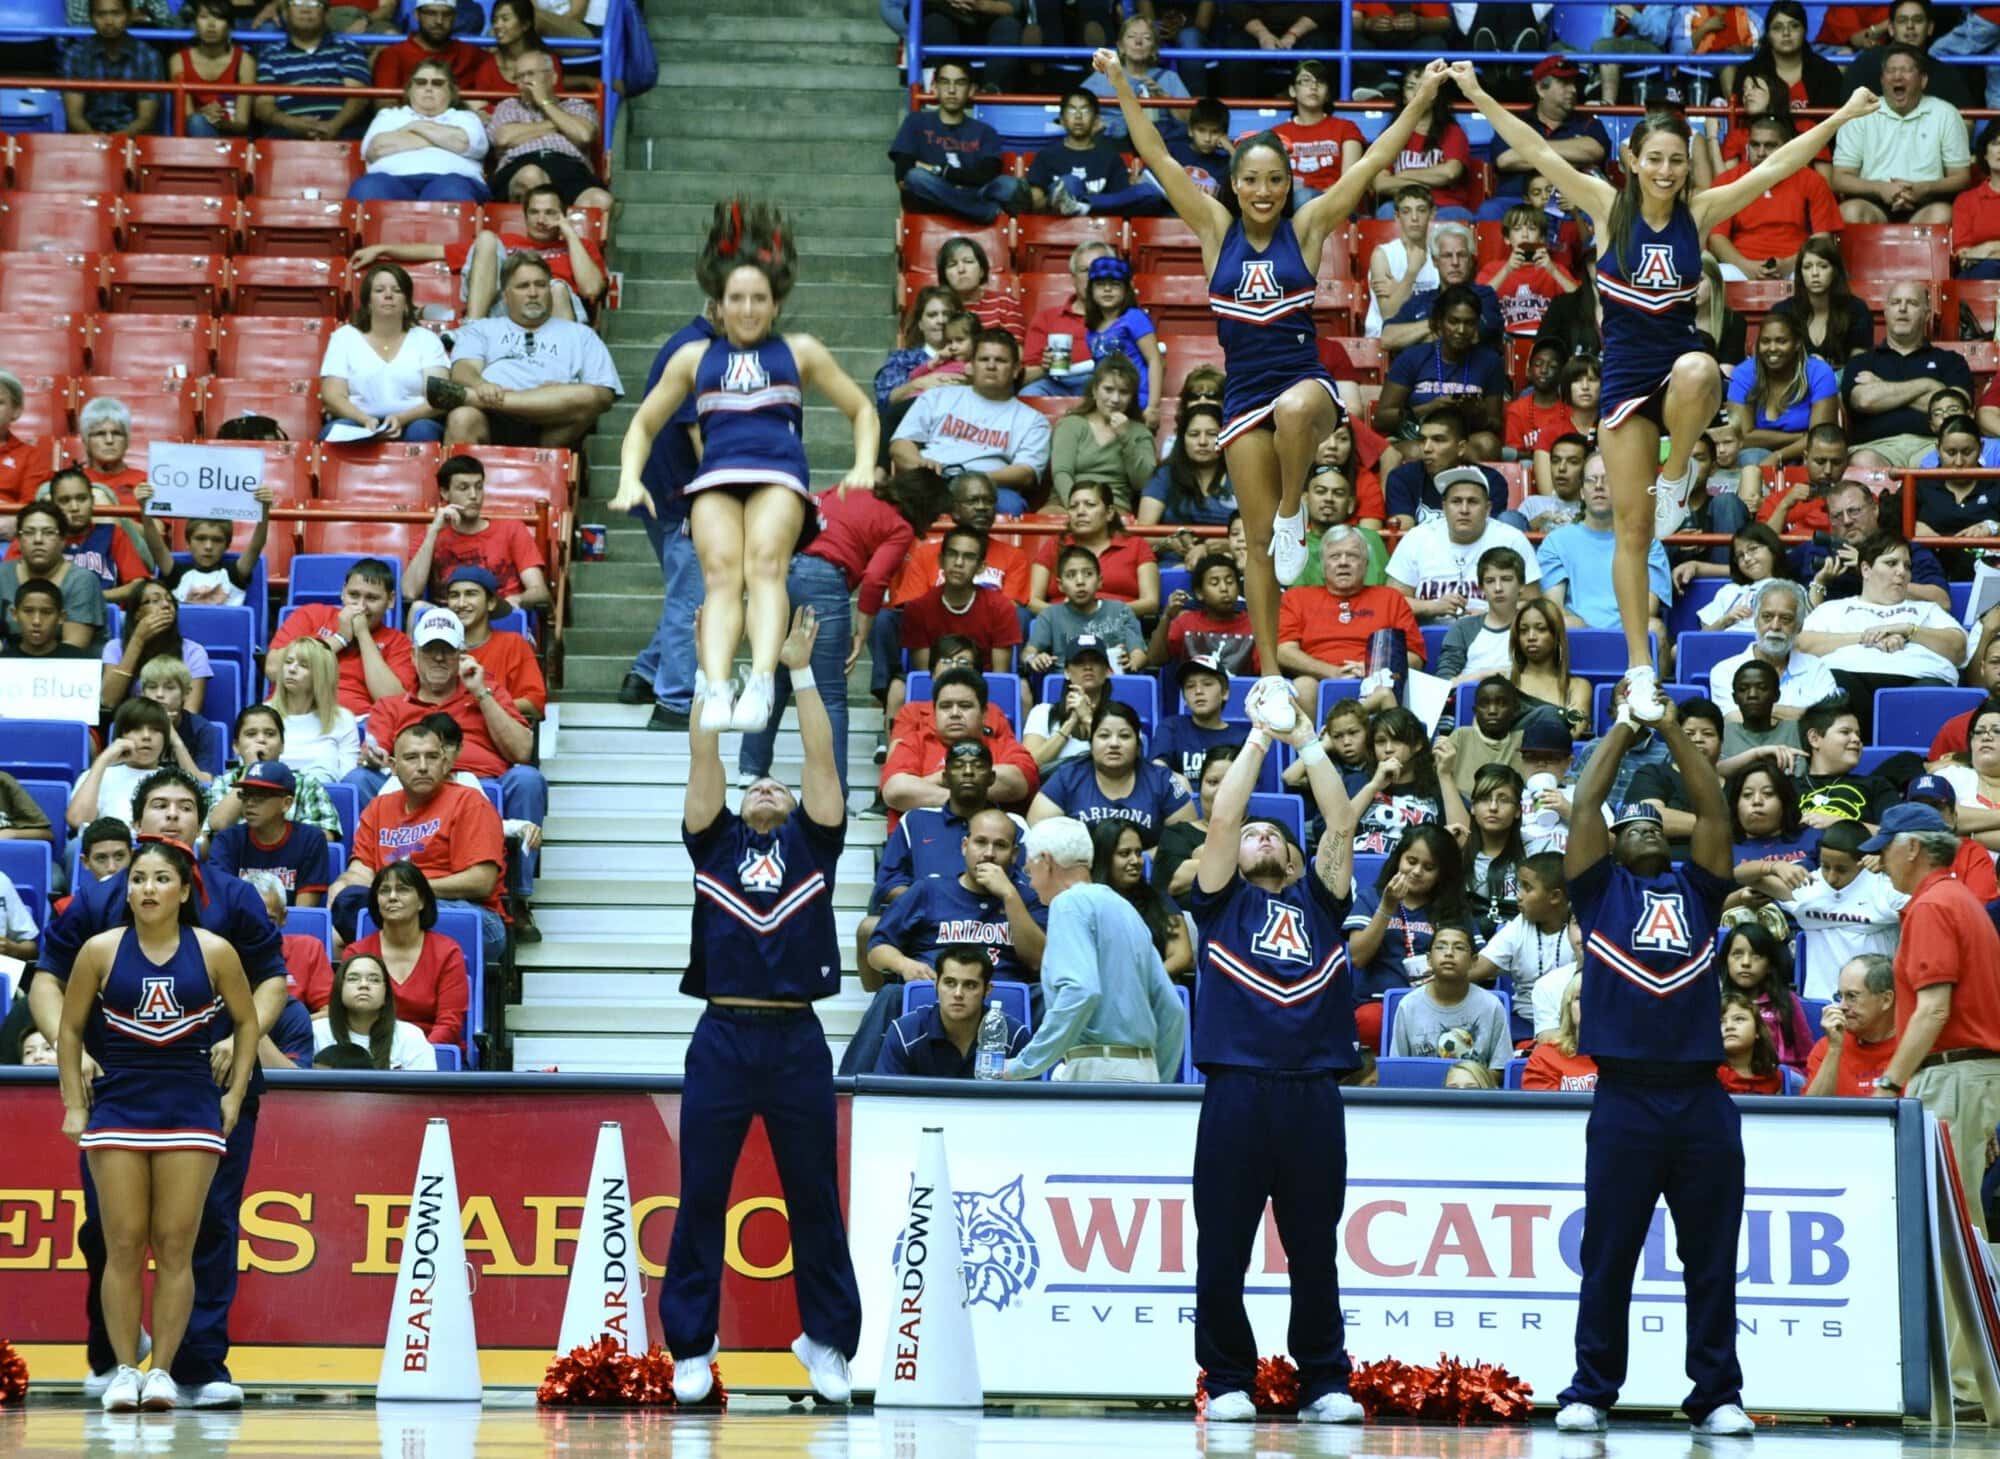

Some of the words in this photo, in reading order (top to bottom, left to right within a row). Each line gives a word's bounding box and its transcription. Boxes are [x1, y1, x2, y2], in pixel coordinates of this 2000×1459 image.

[1234, 260, 1284, 304] A
[1632, 243, 1682, 290] A
[720, 350, 770, 392] A
[938, 411, 1010, 451] ARIZONA
[151, 463, 189, 488] Go
[199, 466, 258, 493] Blue
[1418, 579, 1488, 601] ARIZON
[32, 676, 94, 699] Blue
[1077, 805, 1152, 829] ARIZONA
[737, 839, 786, 893] A
[935, 919, 1015, 945] ARIZON
[1250, 898, 1313, 966] A
[1631, 889, 1693, 957] A
[133, 976, 184, 1023] A
[1051, 1305, 1198, 1324] EVER
